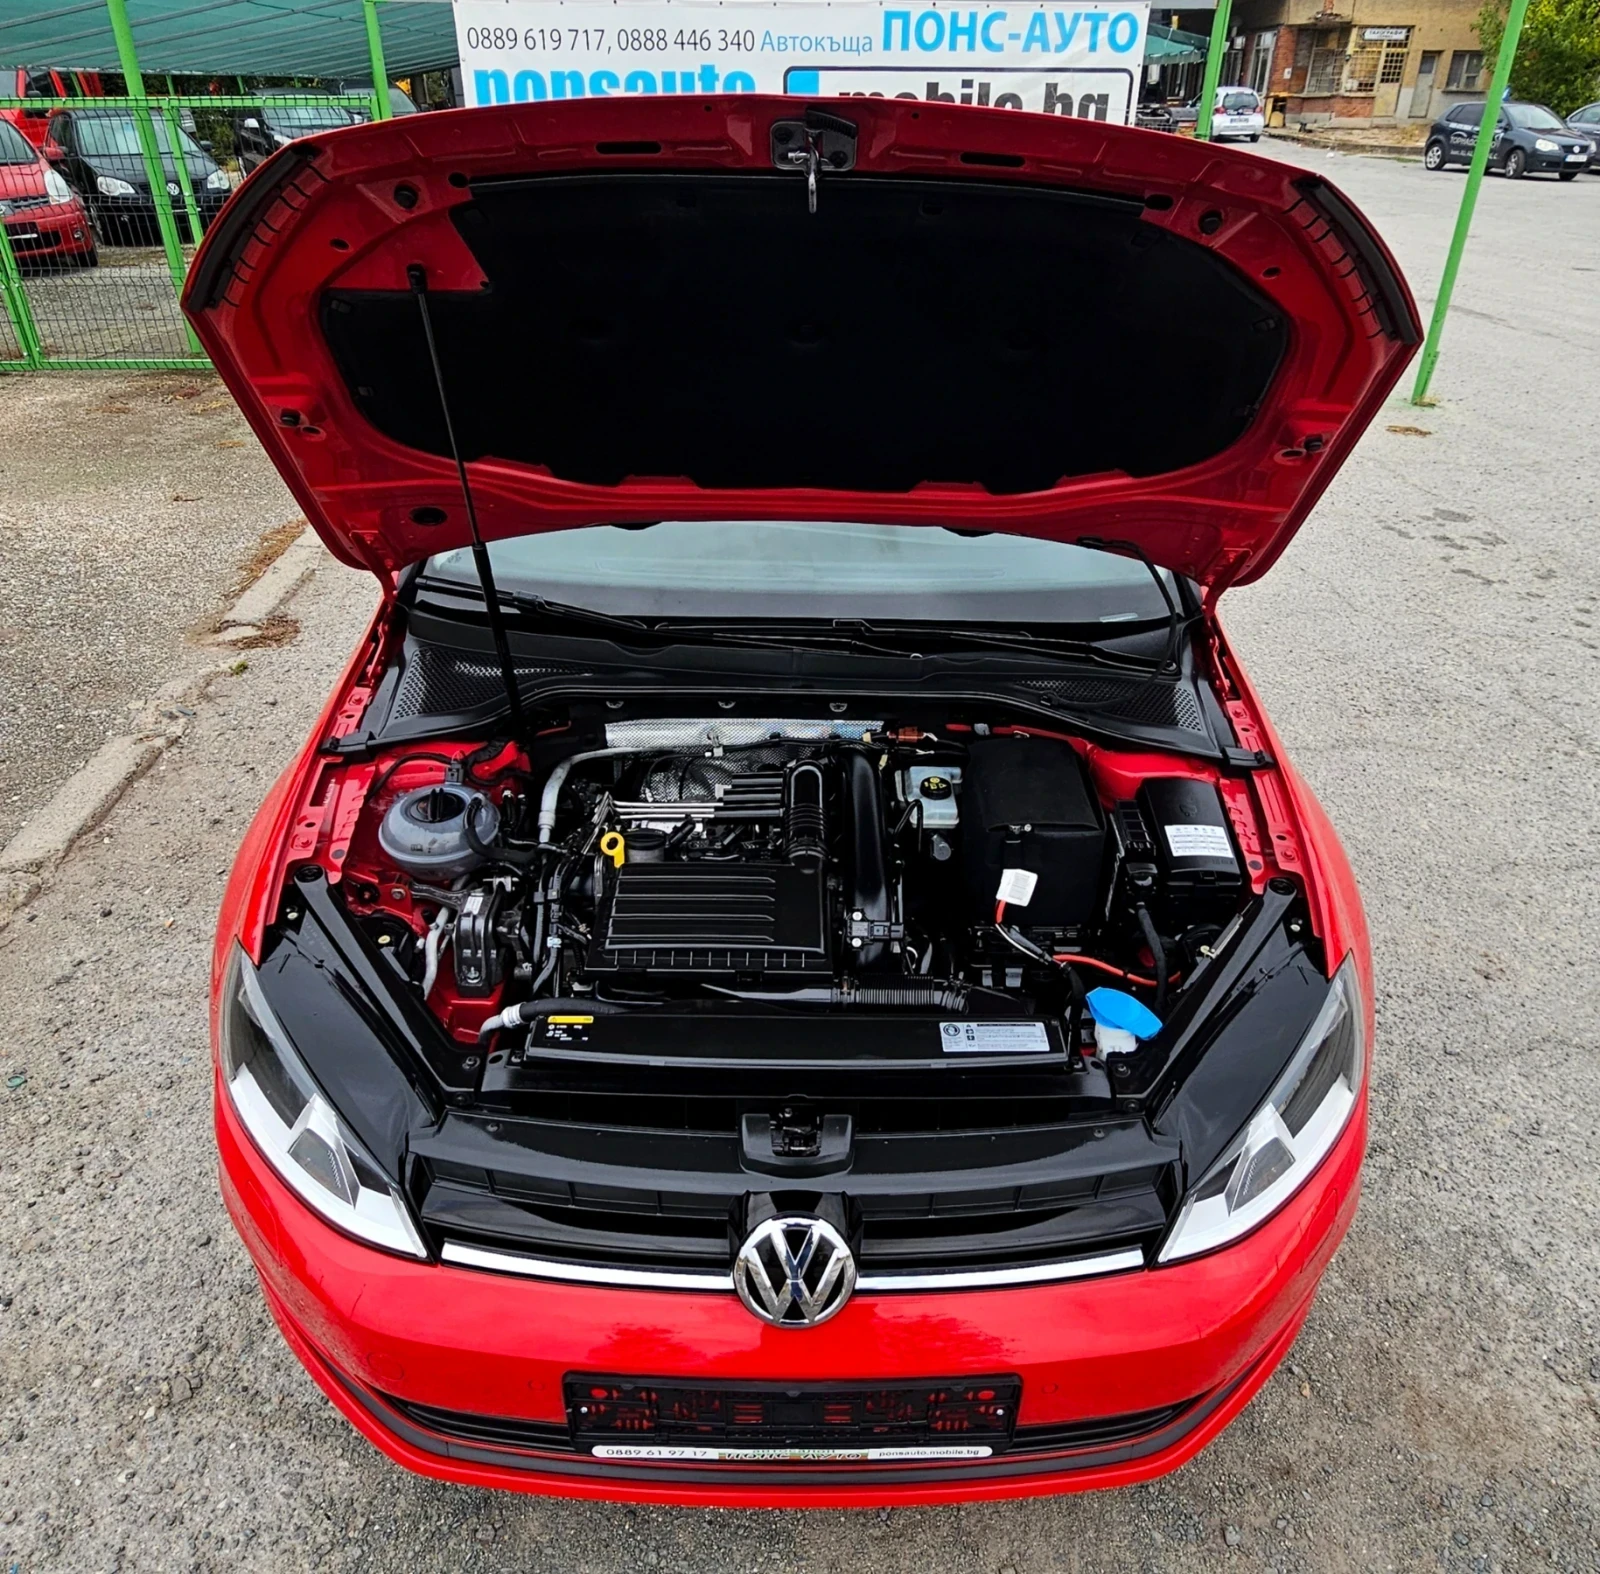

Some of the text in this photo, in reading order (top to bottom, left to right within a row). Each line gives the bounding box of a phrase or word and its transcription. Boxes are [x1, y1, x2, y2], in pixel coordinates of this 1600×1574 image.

[467, 10, 1139, 54] 0889 619 717, 0888 446 340 Автокъща ПОНС-АУТО
[879, 1448, 980, 1458] ponsauto.mobile.bg
